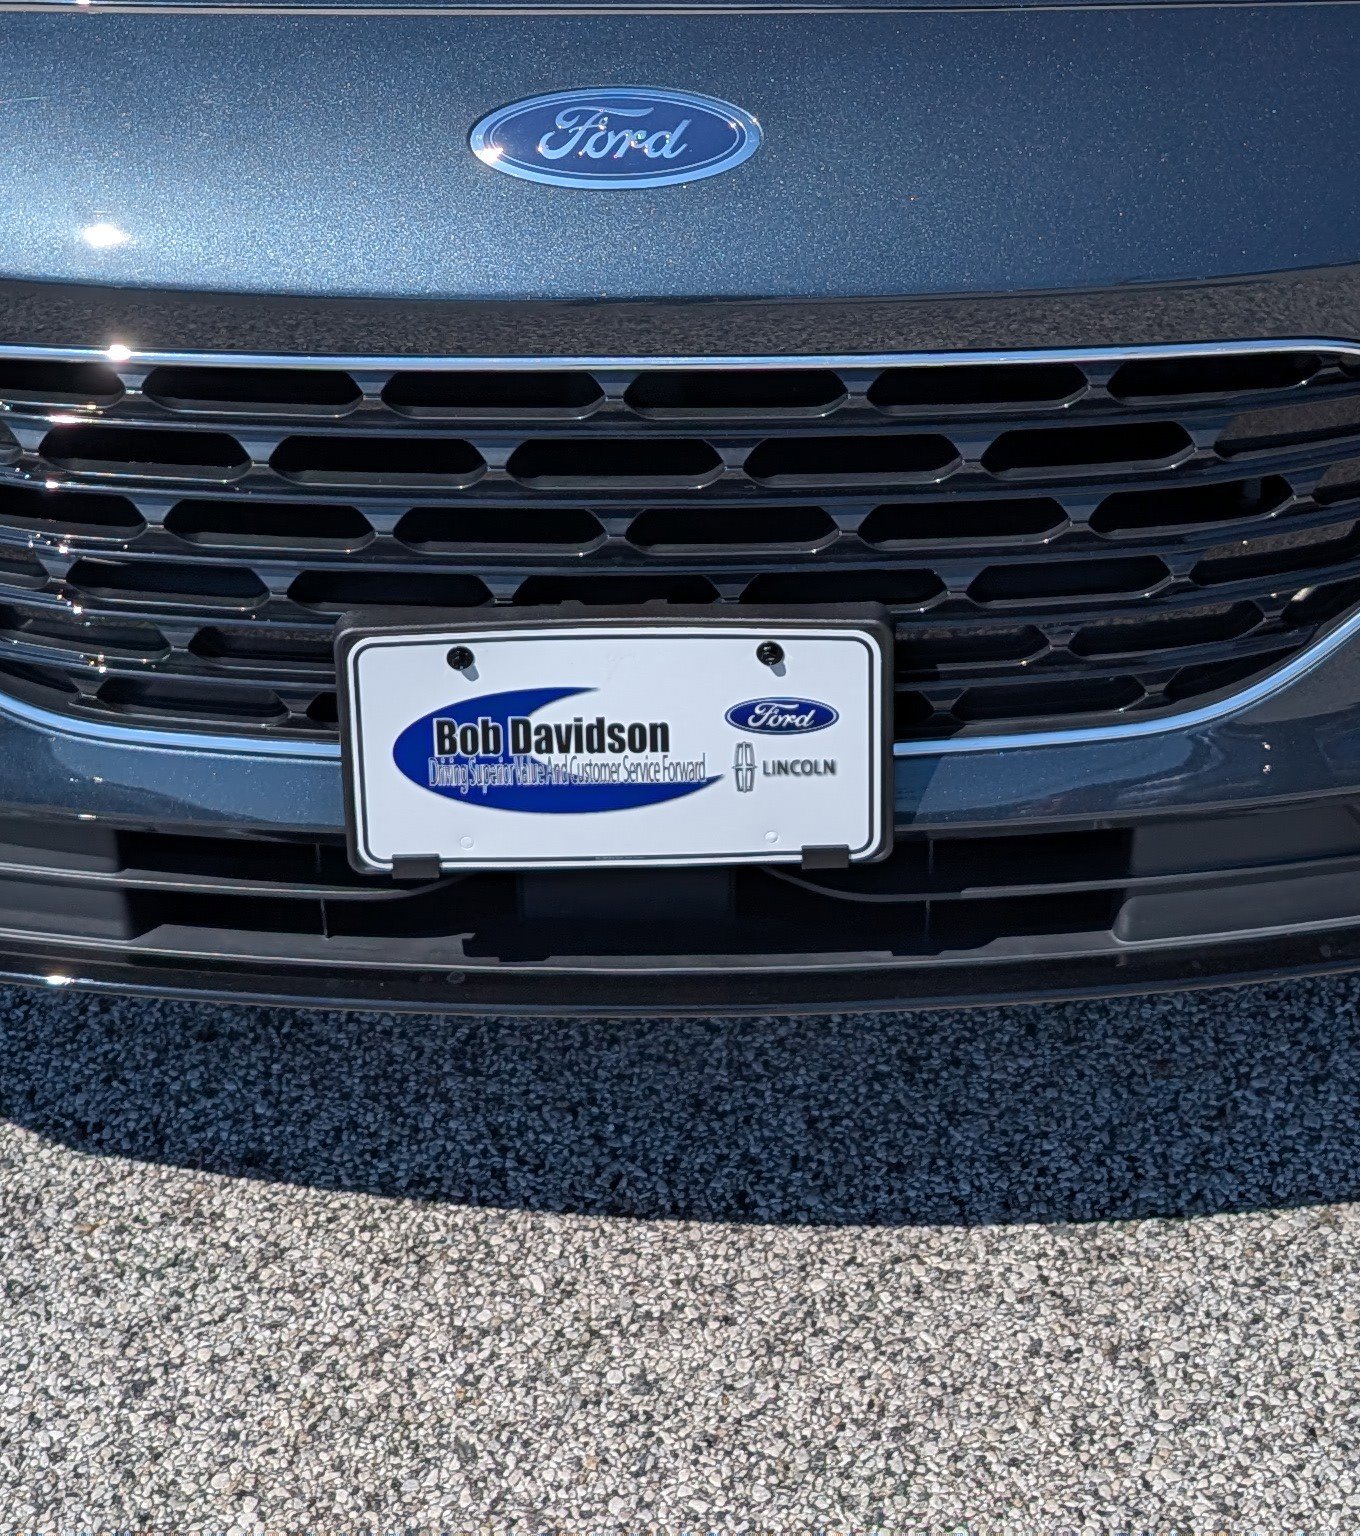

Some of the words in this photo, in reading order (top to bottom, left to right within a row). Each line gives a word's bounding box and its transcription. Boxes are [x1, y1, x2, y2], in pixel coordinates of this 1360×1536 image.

[540, 106, 691, 160] Ford
[747, 702, 816, 728] Ford
[434, 717, 503, 757] Bob
[508, 716, 670, 756] Davidson
[428, 757, 469, 794] Driving
[468, 757, 516, 795] Superior
[513, 756, 545, 786] Value
[546, 755, 569, 785] And
[569, 755, 622, 784] Customer
[622, 754, 661, 783] Service
[662, 752, 706, 782] Forward
[762, 758, 837, 777] LINCOLN
